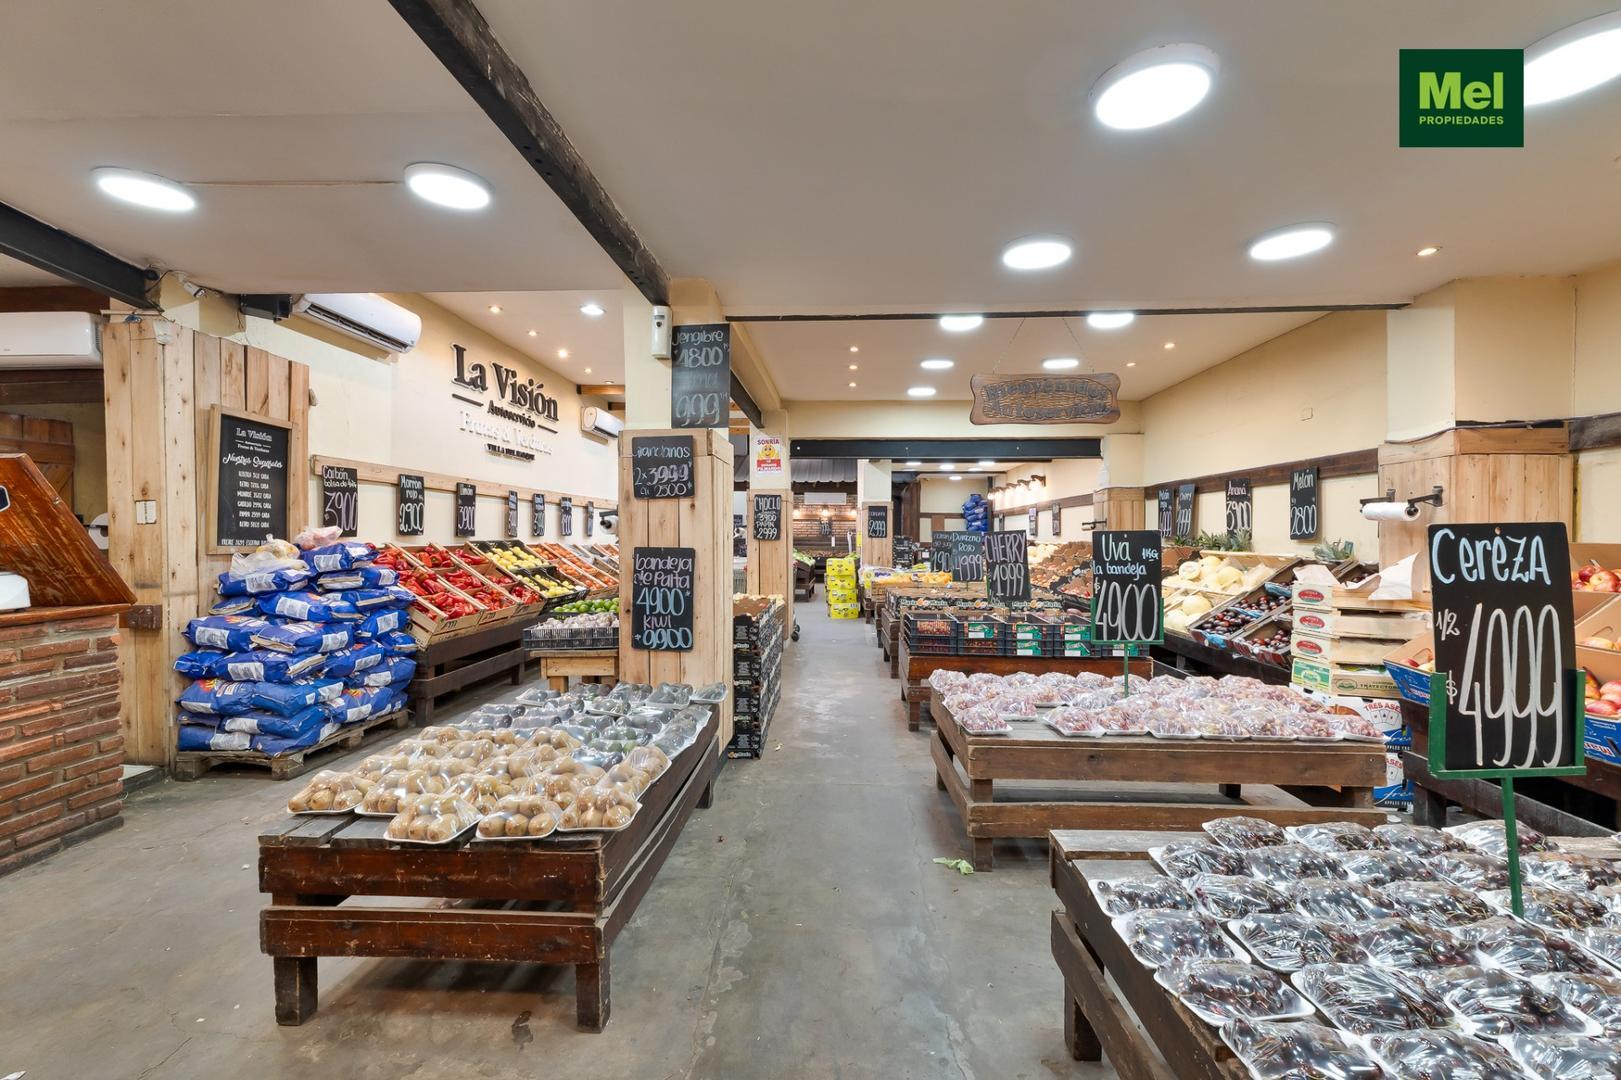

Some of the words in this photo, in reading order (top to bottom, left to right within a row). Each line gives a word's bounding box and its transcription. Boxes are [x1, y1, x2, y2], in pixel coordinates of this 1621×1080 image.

[452, 343, 488, 392] La
[491, 362, 560, 422] Visión
[487, 400, 536, 428] Autoservicio
[235, 428, 247, 437] La
[1290, 505, 1317, 536] 2800
[984, 532, 1026, 563] CHERRY
[1101, 533, 1132, 562] Uva
[635, 553, 693, 573] bandeja
[1106, 562, 1147, 581] bandeja
[635, 587, 685, 616] 4900
[1385, 702, 1401, 713] ASE
